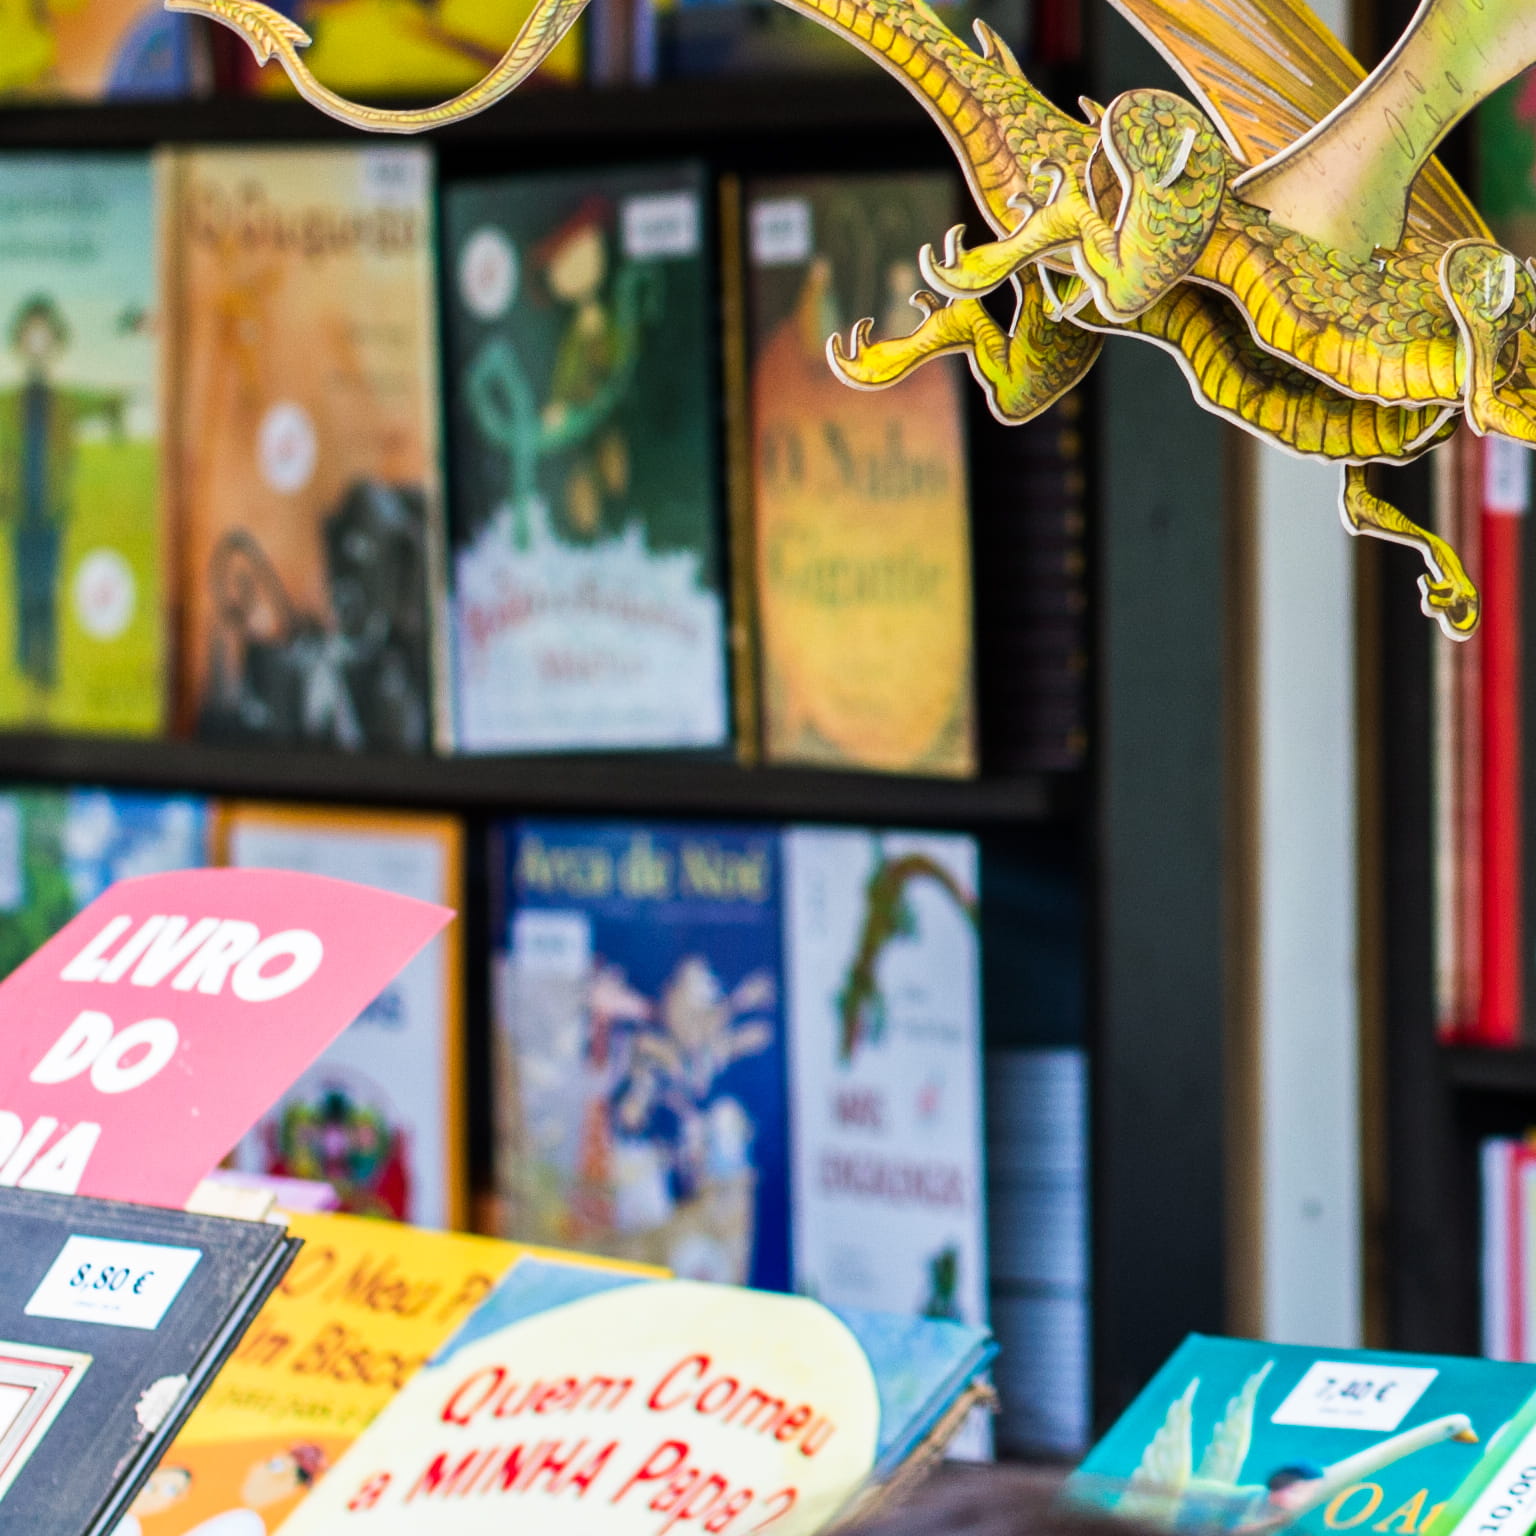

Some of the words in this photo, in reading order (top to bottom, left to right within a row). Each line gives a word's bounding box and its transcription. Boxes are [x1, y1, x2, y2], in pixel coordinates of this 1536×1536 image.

[60, 915, 323, 1002] LIVRO
[29, 1010, 179, 1094] DO
[70, 1262, 129, 1294] 8,80
[133, 1270, 156, 1296] €
[283, 1244, 336, 1298] O
[344, 1253, 440, 1321] Meu
[441, 1366, 635, 1426] Quem
[645, 1352, 837, 1458] Comeu
[1315, 1376, 1374, 1401] 7,40
[346, 1471, 393, 1512] a
[403, 1438, 621, 1504] MINHA
[1323, 1482, 1384, 1531] O
